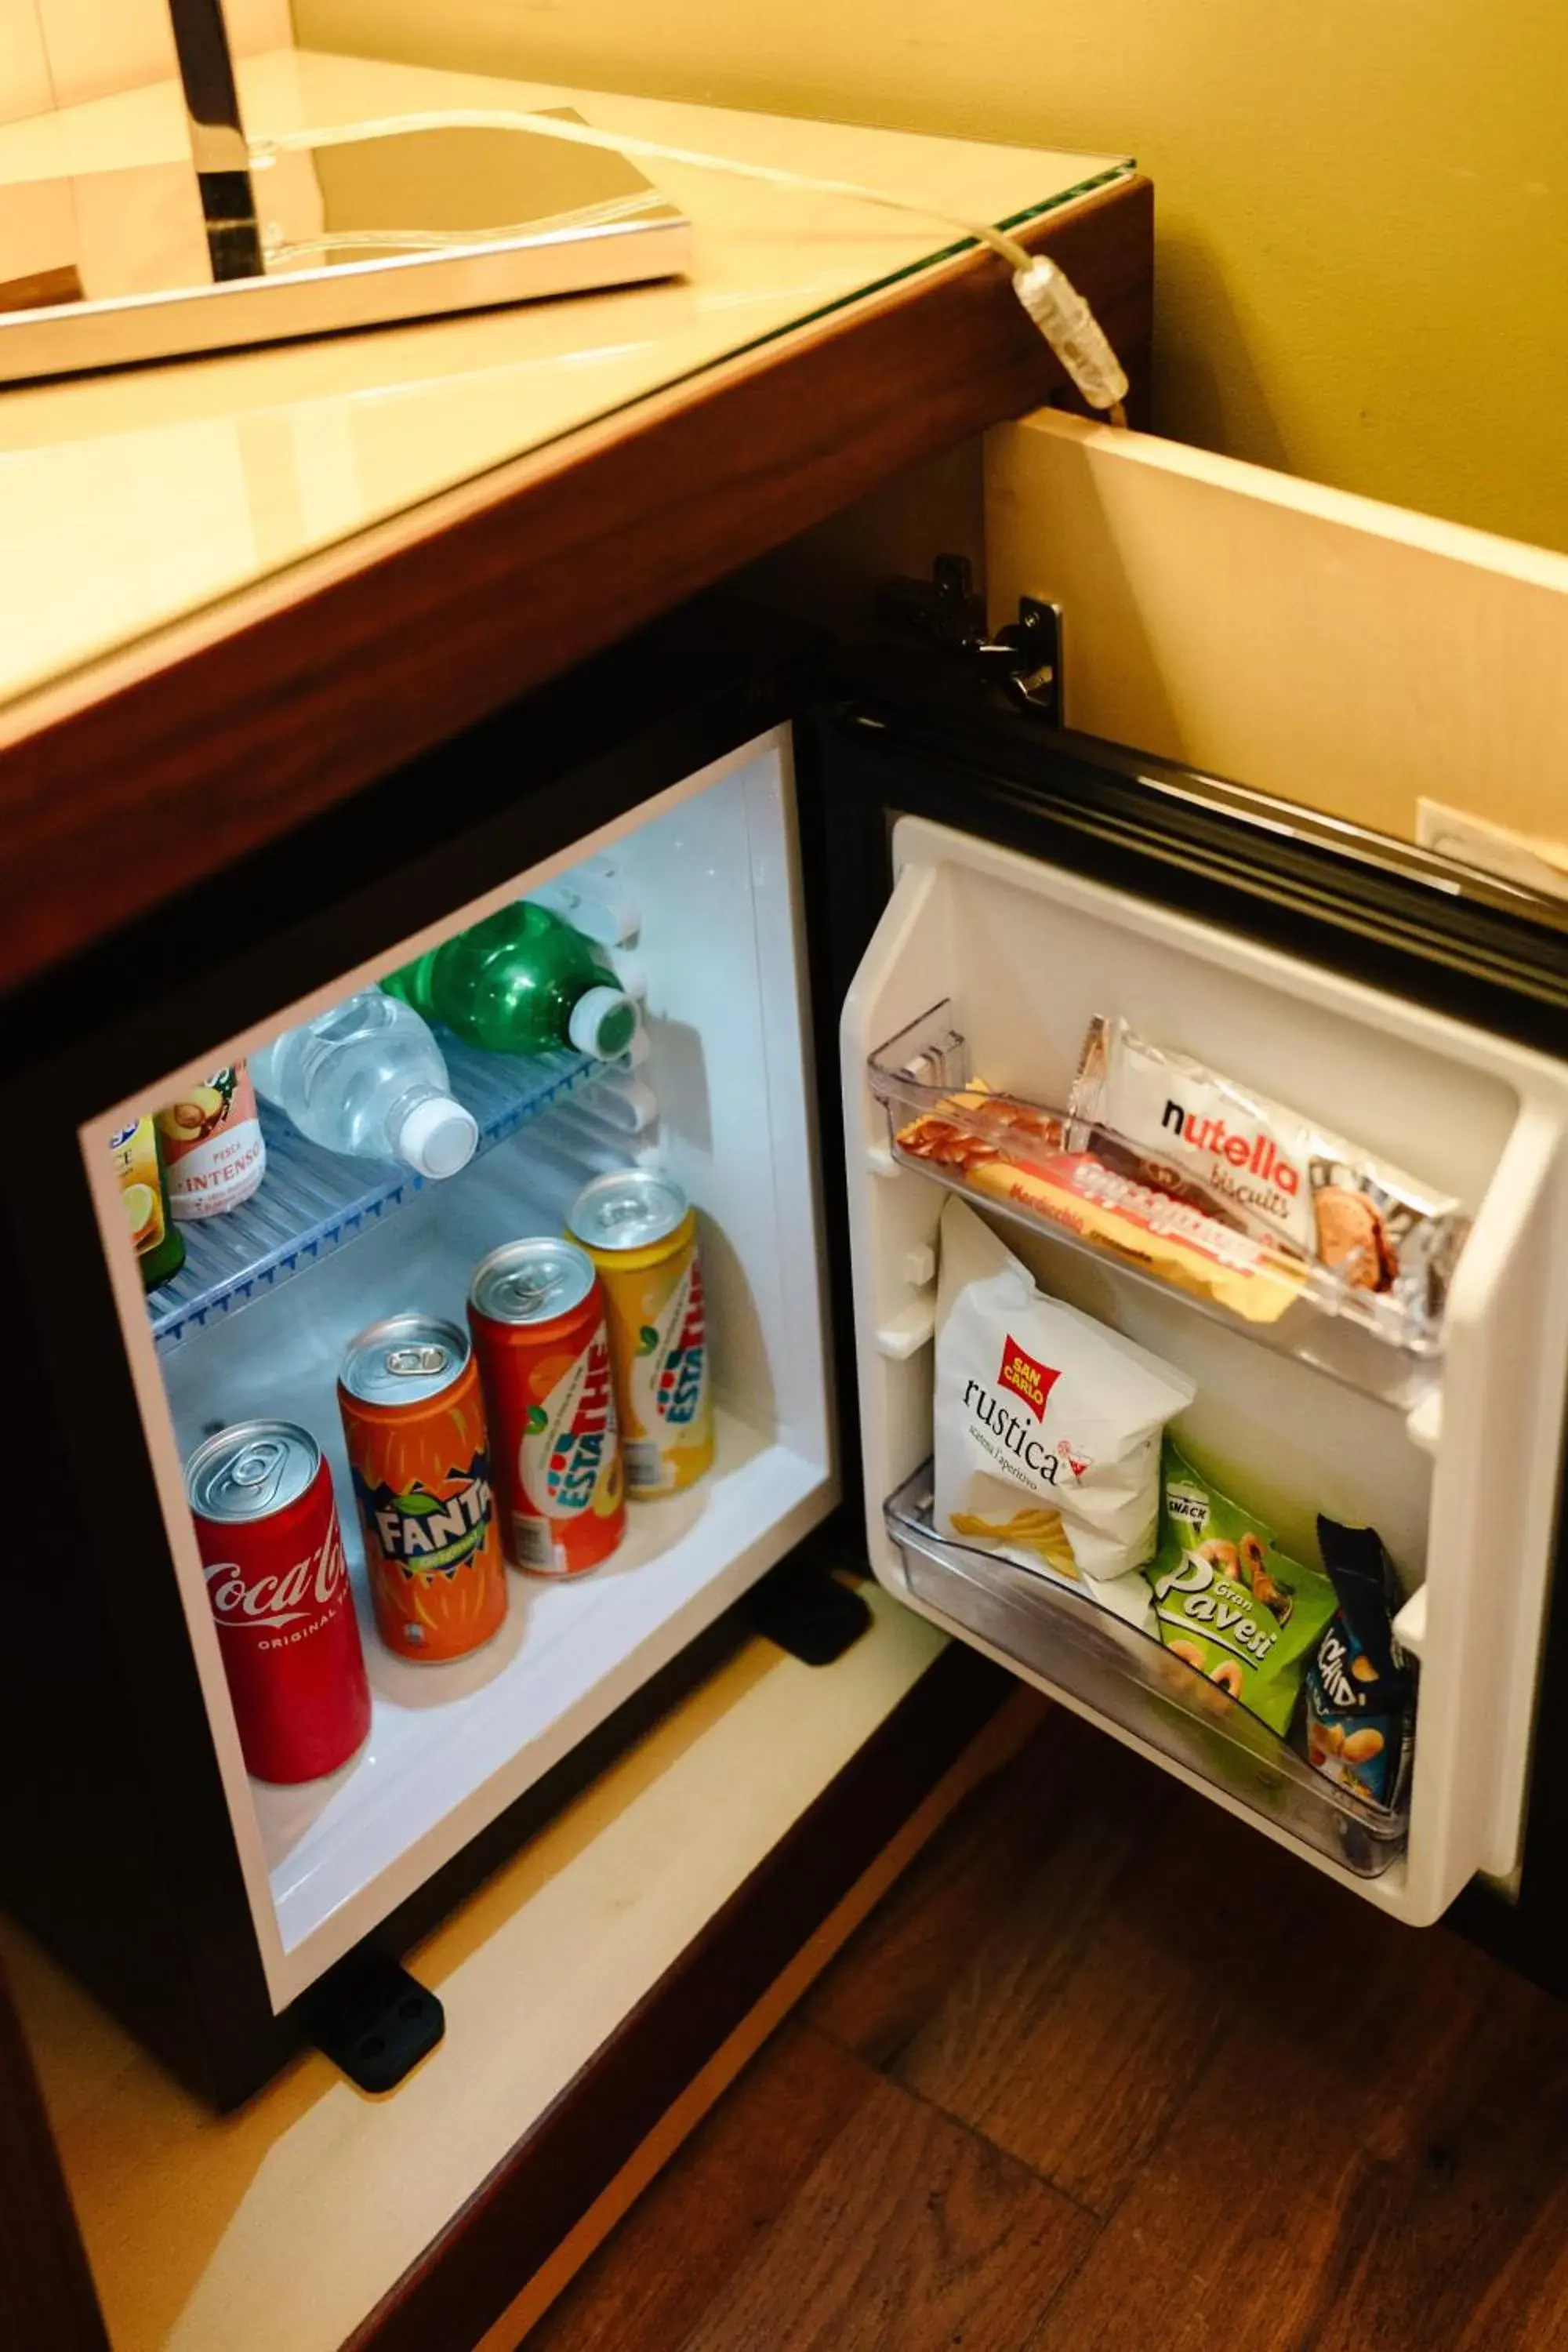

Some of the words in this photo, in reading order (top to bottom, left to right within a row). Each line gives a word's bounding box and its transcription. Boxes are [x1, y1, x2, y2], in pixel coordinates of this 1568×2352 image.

[186, 1139, 260, 1192] INTENSO
[1161, 1098, 1300, 1197] nutella
[1004, 1365, 1044, 1405] CARLO
[1013, 1357, 1042, 1387] SAN
[964, 1380, 1058, 1486] rustica
[1169, 1500, 1207, 1519] SNACK
[1155, 1548, 1277, 1661] Pavesi
[1216, 1581, 1253, 1612] Gran
[258, 1609, 338, 1650] ORIGINAL
